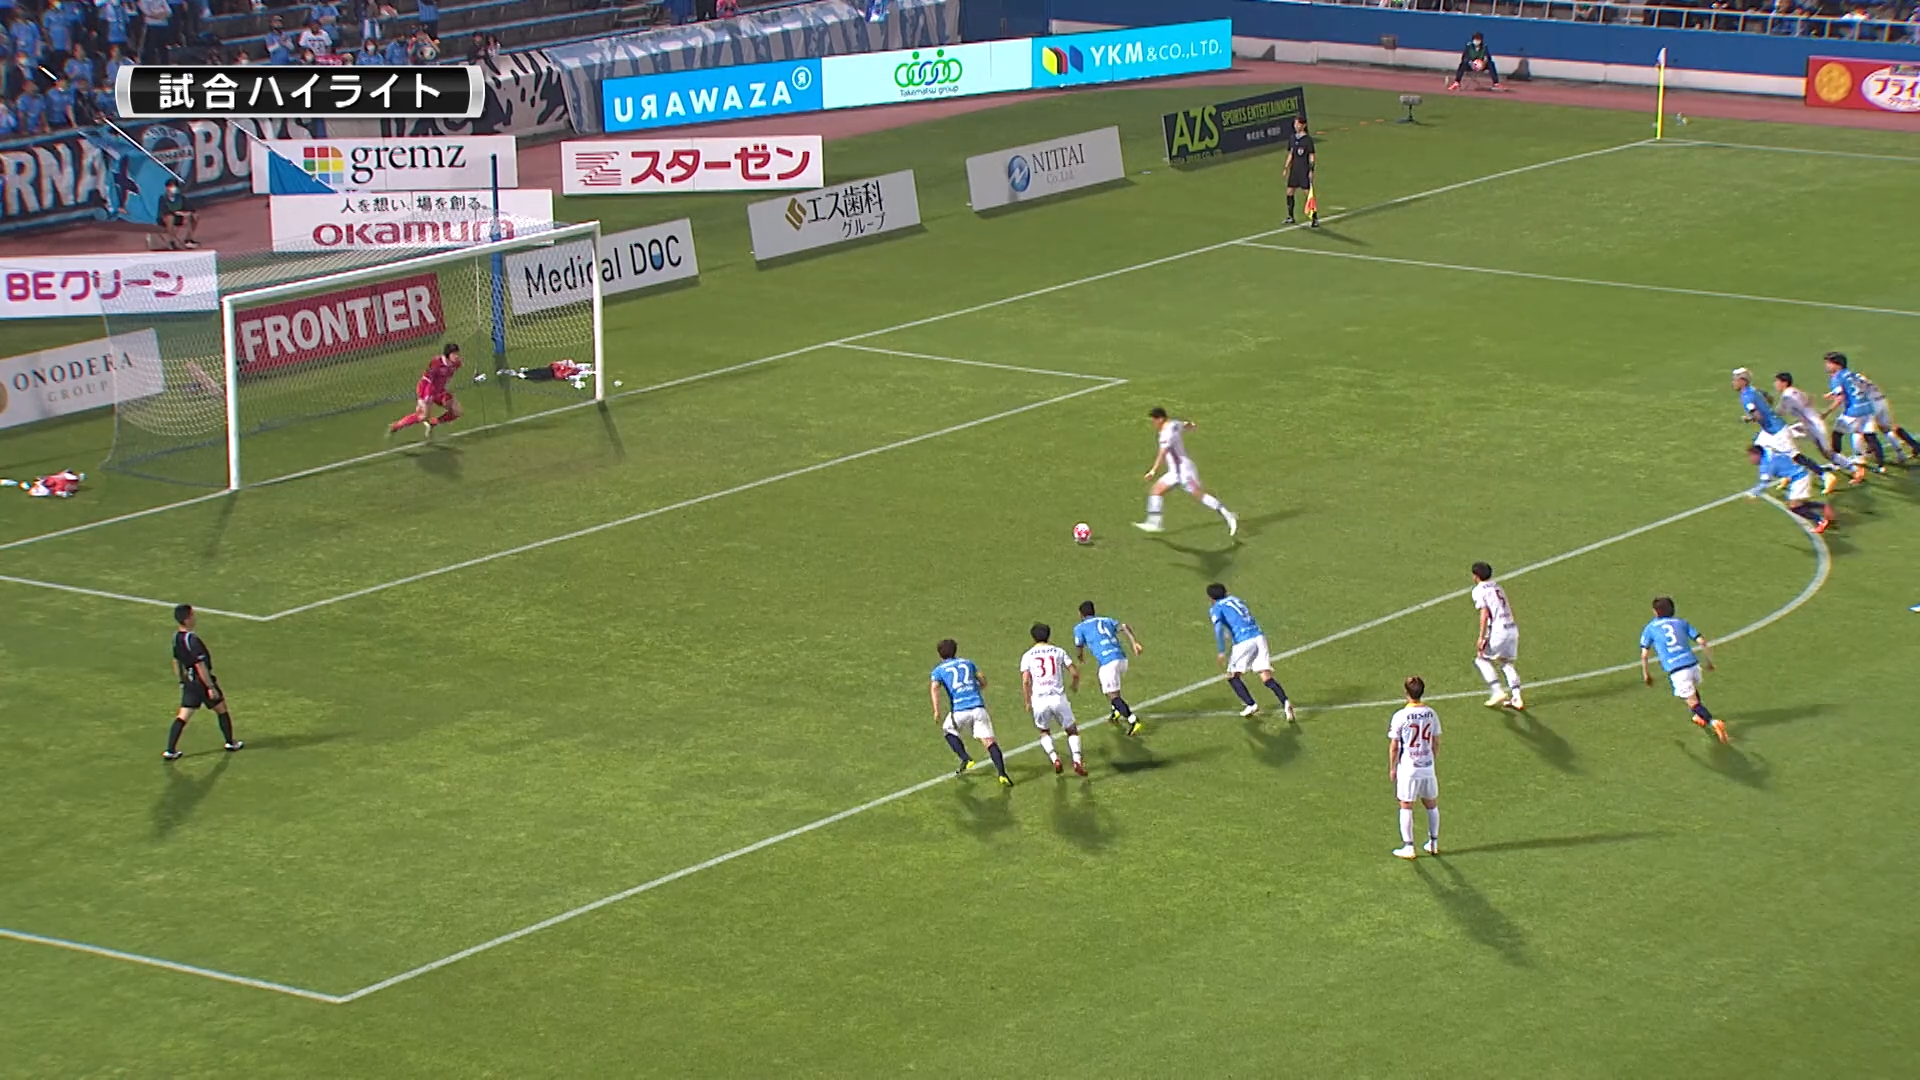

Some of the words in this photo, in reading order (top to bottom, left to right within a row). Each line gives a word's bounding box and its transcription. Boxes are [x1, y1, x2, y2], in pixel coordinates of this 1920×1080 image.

[1090, 41, 1143, 67] YKM
[1874, 77, 1920, 98] プライ
[1171, 104, 1220, 156] AZS
[1221, 107, 1247, 126] SPORTS
[1248, 96, 1298, 119] ENTERTAINMENT
[350, 144, 467, 184] gremz
[630, 143, 811, 184] スターゼン
[1031, 144, 1086, 174] NITTAI
[806, 179, 884, 223] エス歯科
[842, 211, 886, 238] グループ
[629, 235, 682, 276] DOC
[6, 269, 184, 301] BEクリーン
[241, 285, 437, 363] FRONTIER
[13, 351, 136, 392] ONODERA
[47, 380, 109, 402] GROUP
[1096, 618, 1112, 638] 4
[1661, 624, 1677, 646] 3
[945, 664, 974, 689] 22
[1034, 656, 1056, 677] 31
[1408, 722, 1431, 748] 24
